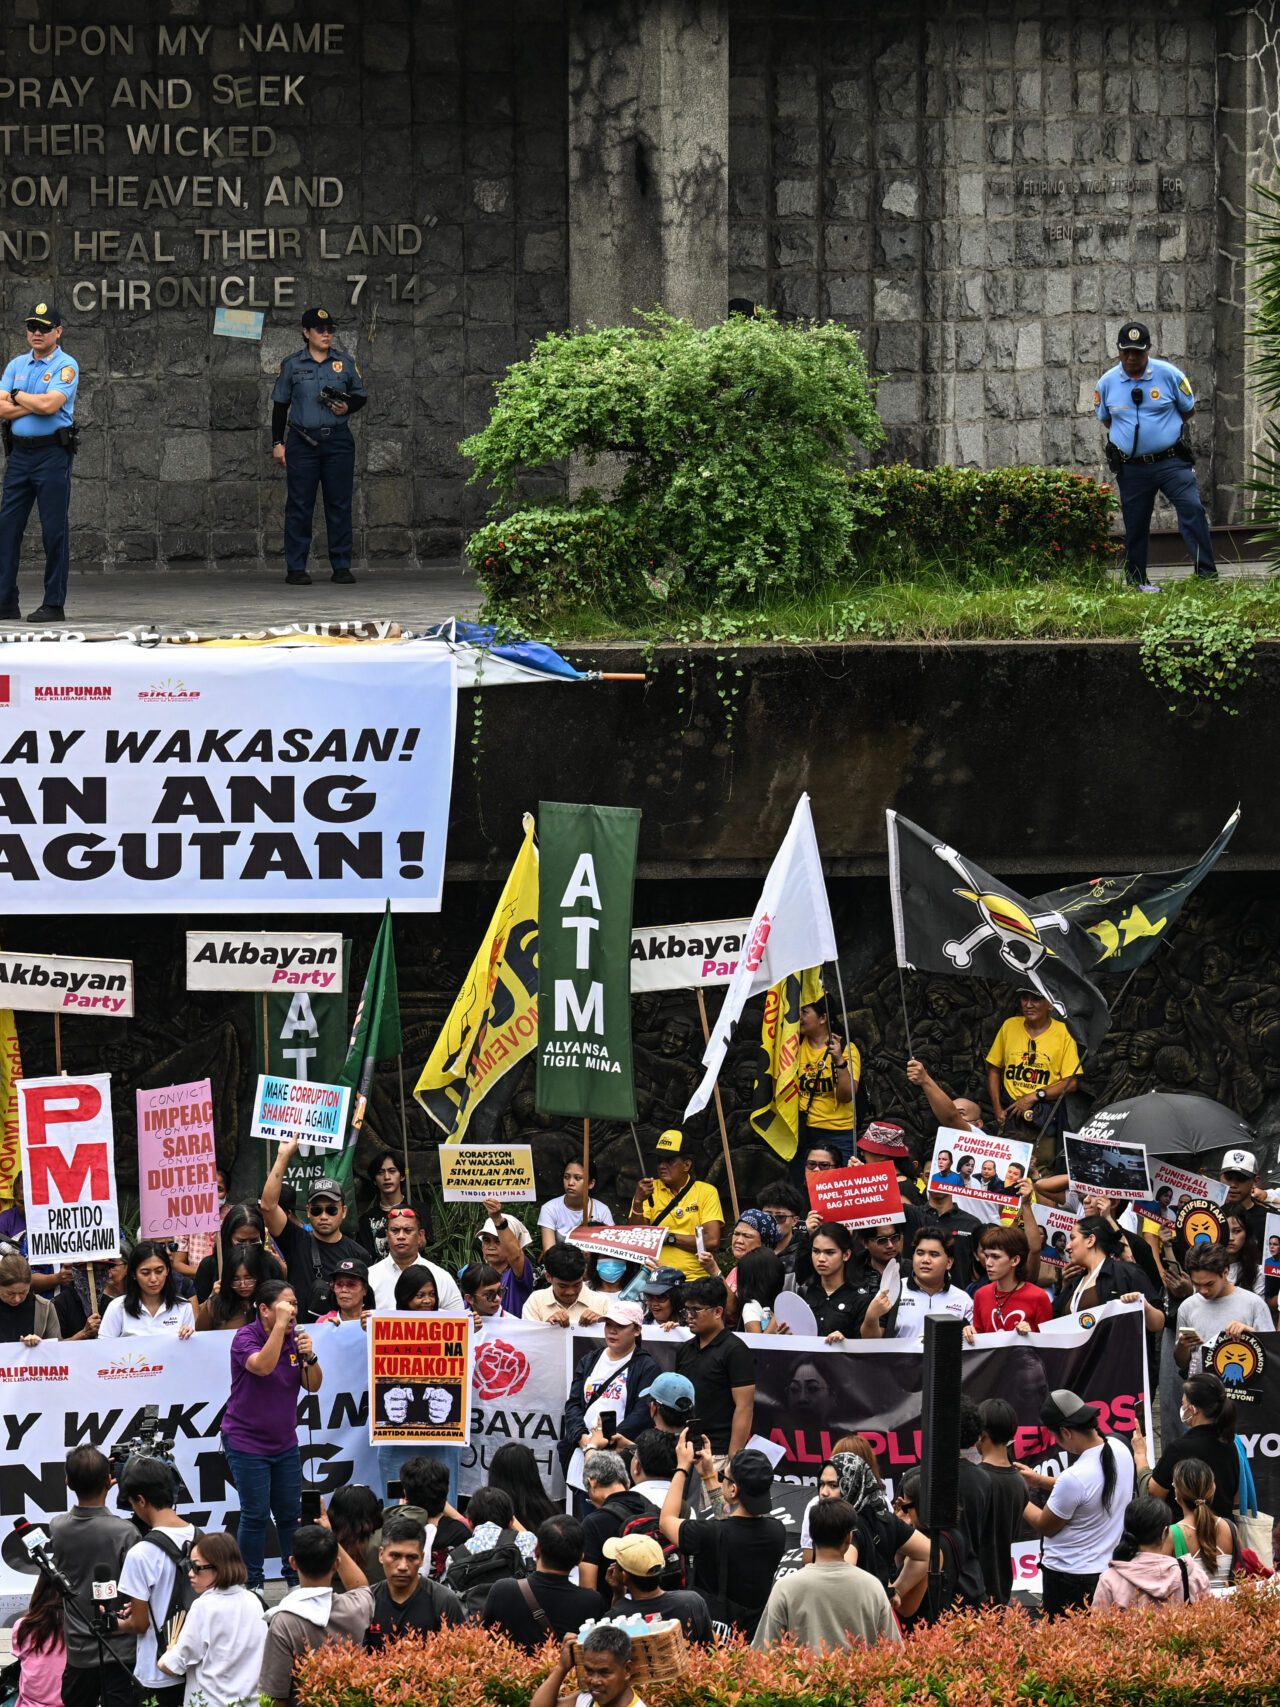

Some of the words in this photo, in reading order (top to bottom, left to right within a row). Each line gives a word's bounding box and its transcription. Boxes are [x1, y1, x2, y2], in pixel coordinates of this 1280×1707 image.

[28, 25, 134, 56] UPON
[158, 24, 212, 56] MY
[239, 23, 344, 55] NAME
[111, 78, 192, 109] AND
[212, 74, 305, 109] SEEK
[126, 124, 277, 158] WICKED
[90, 175, 248, 210] HEAVEN,
[265, 176, 344, 208] AND
[74, 229, 175, 263] HEAL
[195, 227, 303, 260] THEIR
[72, 275, 295, 312] CHRONICLE
[34, 686, 112, 696] KALIPUNAN
[138, 690, 201, 698] SIKLAB
[1, 730, 85, 764] AY
[105, 728, 421, 764] WAKASAN!
[152, 775, 377, 824] ANG
[193, 940, 338, 968] Akbayan
[554, 853, 605, 1036] ATM
[271, 968, 336, 988] Party
[62, 992, 126, 1012] Party
[545, 1040, 609, 1058] ALYANSA
[542, 1054, 580, 1068] TIGIL
[585, 1057, 622, 1074] MINA
[1006, 1062, 1050, 1086] atom
[149, 1085, 208, 1108] CONVICT
[265, 1082, 288, 1100] MAKE
[290, 1086, 340, 1108] CORRUPTION
[262, 1102, 302, 1125] SHAMEFUL
[304, 1110, 338, 1132] AGAIN!
[155, 1122, 210, 1139] CONVICT
[260, 1127, 277, 1136] ML
[162, 1132, 214, 1159] SARA
[953, 1143, 1013, 1161] PLUNDERERS
[958, 1135, 993, 1149] PUNISH
[994, 1142, 1010, 1152] ALL
[450, 1168, 500, 1176] SIMULAN
[503, 1168, 525, 1176] ANG
[455, 1158, 468, 1166] AY
[469, 1158, 515, 1166] WAKASAN!
[446, 1177, 531, 1186] PANANAGUTAN!
[816, 1182, 832, 1192] MGA
[834, 1179, 855, 1190] BATA
[856, 1174, 888, 1186] WALANG
[1154, 1172, 1209, 1198] PLUNDERERS
[1159, 1166, 1192, 1184] PUNISH
[1193, 1176, 1208, 1190] ALL
[818, 1190, 843, 1202] PAPEL,
[844, 1187, 860, 1198] SILA
[860, 1185, 878, 1195] MAY
[879, 1184, 889, 1193] LV
[937, 1183, 972, 1196] AKBAYAN
[973, 1190, 1013, 1204] PARTYLIST
[1075, 1183, 1088, 1191] WE
[1088, 1186, 1104, 1196] PAID
[1105, 1189, 1123, 1198] FOR
[1124, 1190, 1145, 1198] THIS!
[168, 1193, 214, 1218] NOW
[826, 1200, 843, 1210] BAG
[844, 1198, 854, 1208] AT
[855, 1194, 884, 1206] CHANEL
[48, 1205, 103, 1231] PARTIDO
[866, 1216, 892, 1226] YOUTH
[1176, 1200, 1208, 1229] CERTIFIED
[31, 1226, 116, 1255] MANGGAGAWA
[374, 1321, 466, 1342] MANAGOT
[384, 1345, 433, 1354] LAHAT
[444, 1342, 464, 1356] NA
[97, 1364, 164, 1376] SIKLAB
[374, 1356, 465, 1376] KURAKOT!
[406, 1430, 464, 1438] MANGGAGAWA
